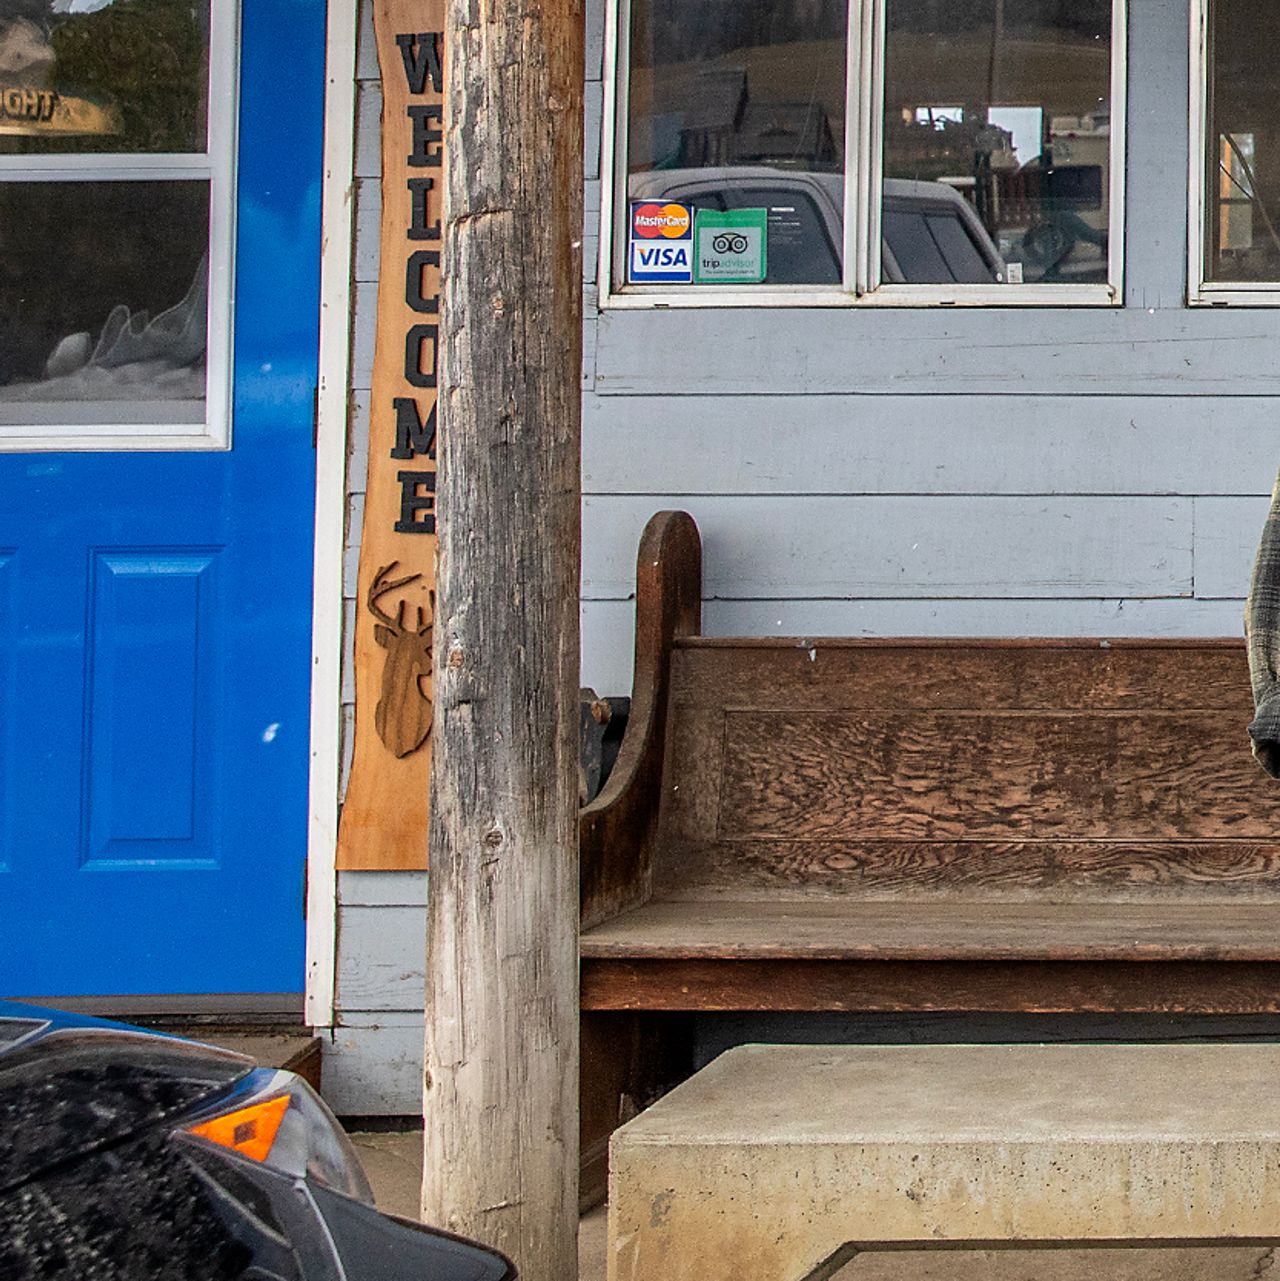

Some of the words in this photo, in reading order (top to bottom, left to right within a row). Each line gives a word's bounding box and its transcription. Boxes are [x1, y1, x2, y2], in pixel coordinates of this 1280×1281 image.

[0, 87, 57, 121] GHT
[635, 215, 689, 227] MasterCard
[638, 248, 687, 266] VISA
[391, 32, 445, 534] WELCOME
